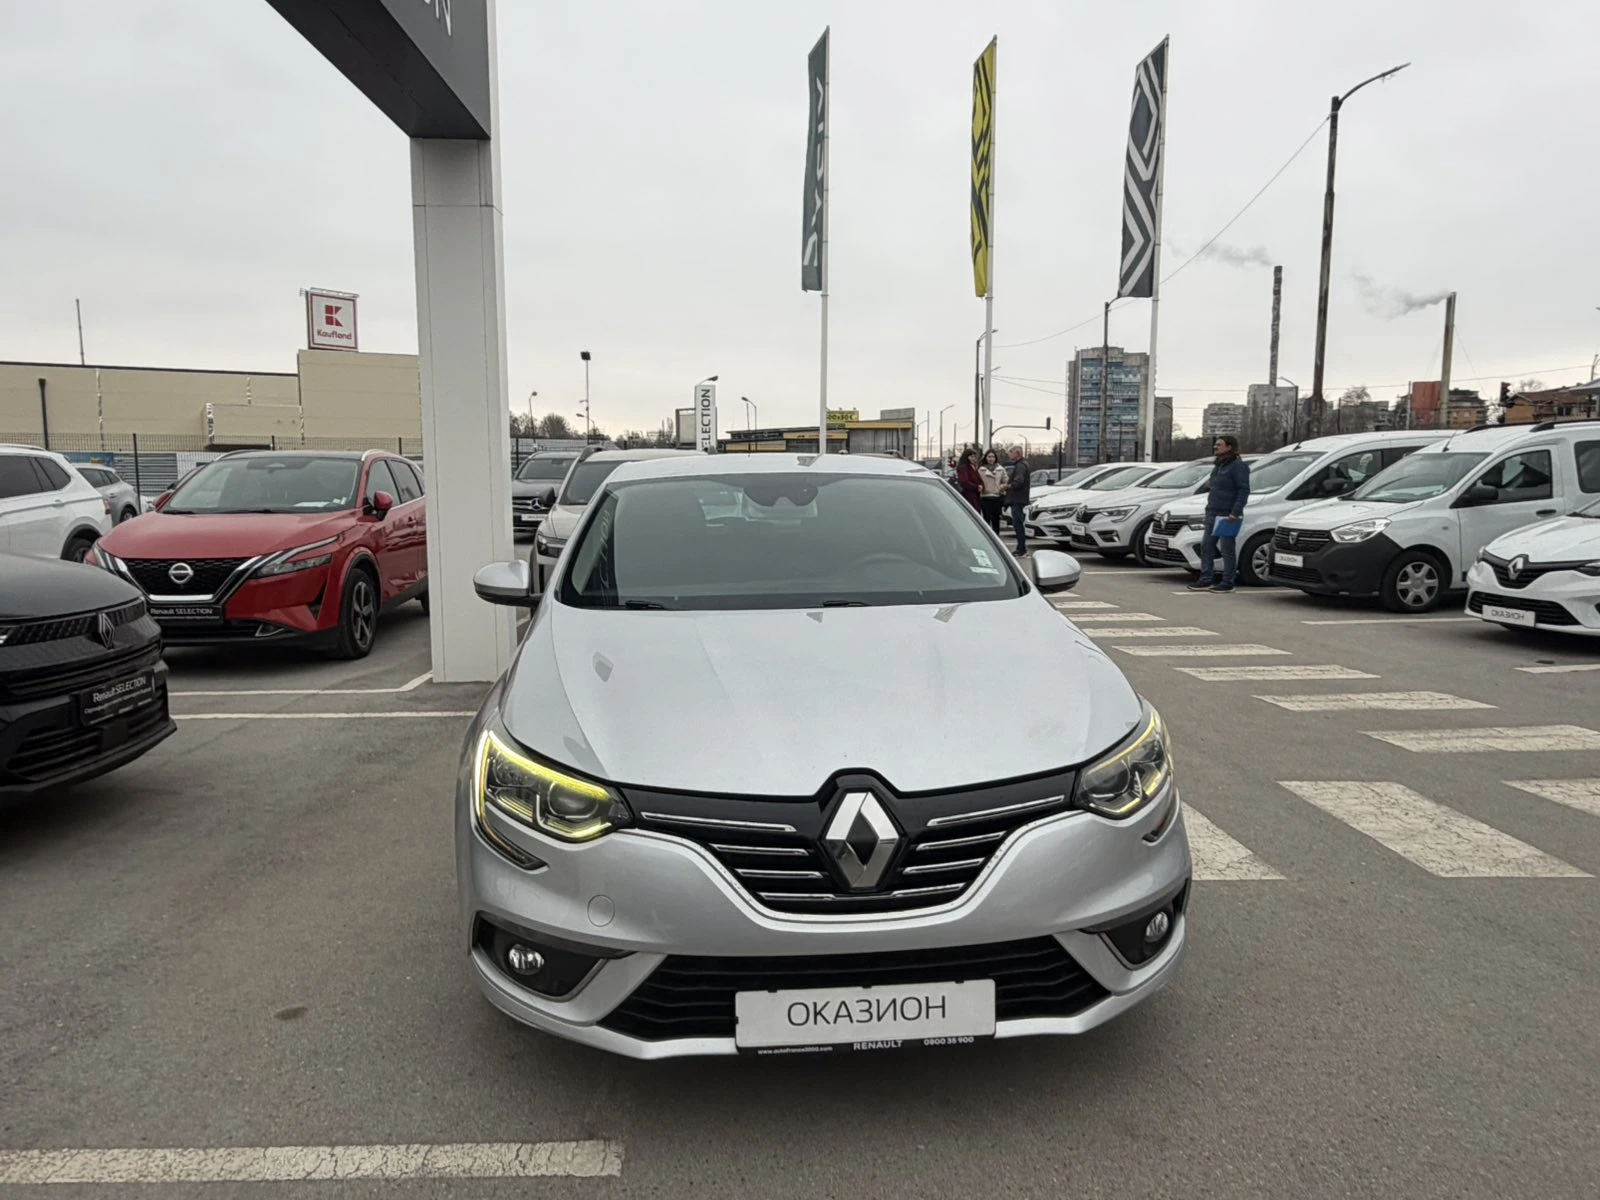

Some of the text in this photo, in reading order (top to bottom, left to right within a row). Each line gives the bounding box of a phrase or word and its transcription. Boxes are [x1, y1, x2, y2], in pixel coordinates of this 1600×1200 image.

[317, 329, 352, 340] Kaufland
[115, 676, 146, 694] SELECTION
[788, 995, 946, 1026] ОКАЗИОН
[853, 1039, 903, 1051] RENAULT
[923, 1038, 946, 1046] 0800
[958, 1036, 975, 1044] 900
